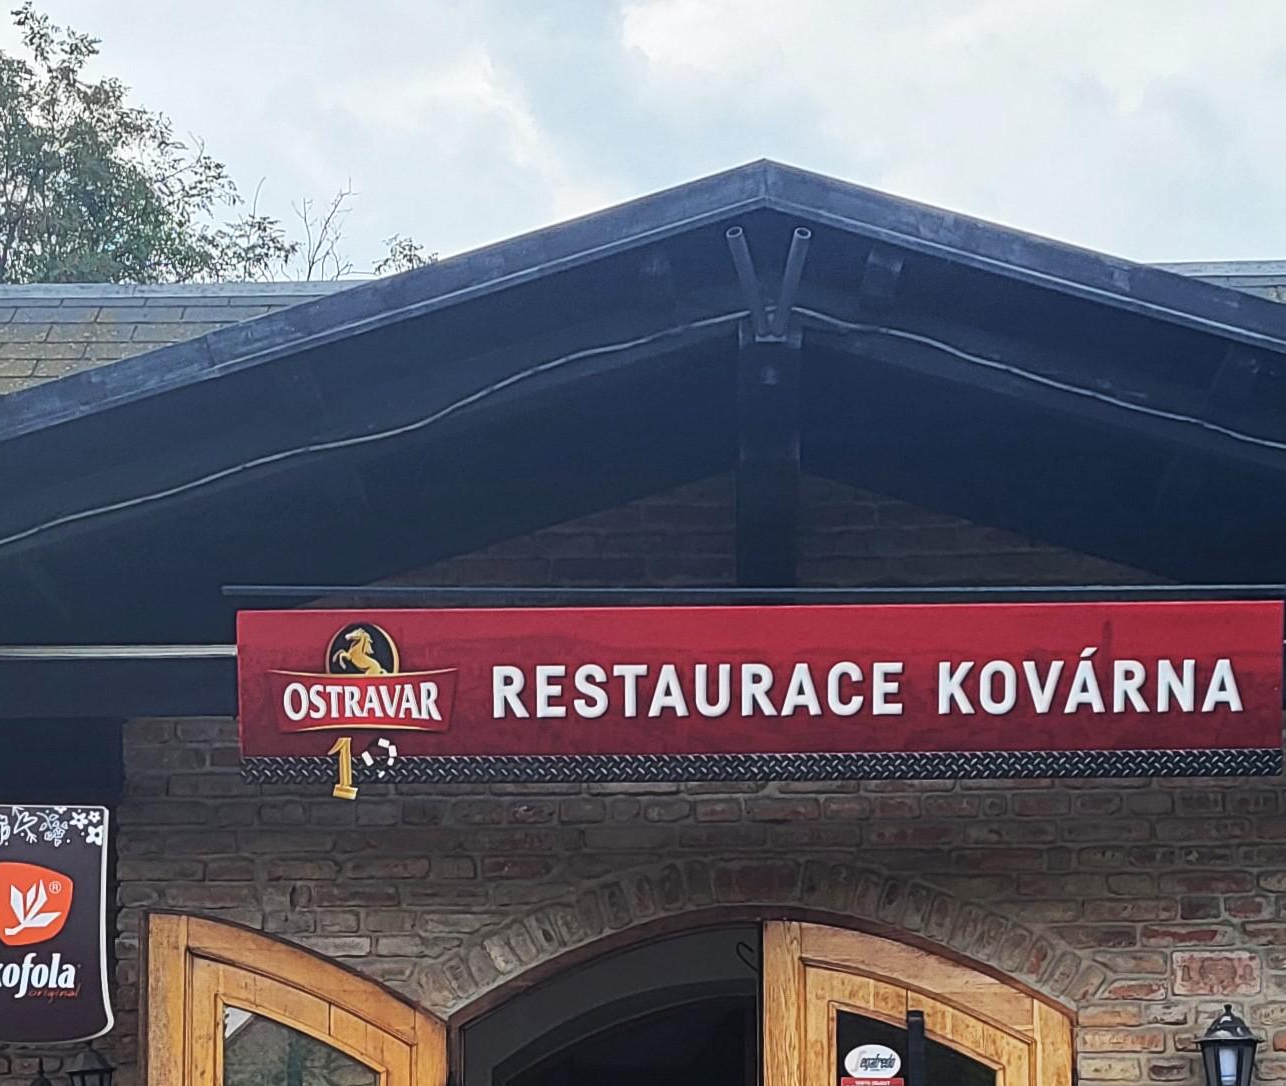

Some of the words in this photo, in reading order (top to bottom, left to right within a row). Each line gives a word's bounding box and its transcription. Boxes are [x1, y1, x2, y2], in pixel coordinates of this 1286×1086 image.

[283, 681, 442, 721] OSTRAVAR
[492, 661, 904, 719] RESTAURACE
[937, 647, 1244, 716] KOVÁRNA
[28, 983, 81, 1004] original
